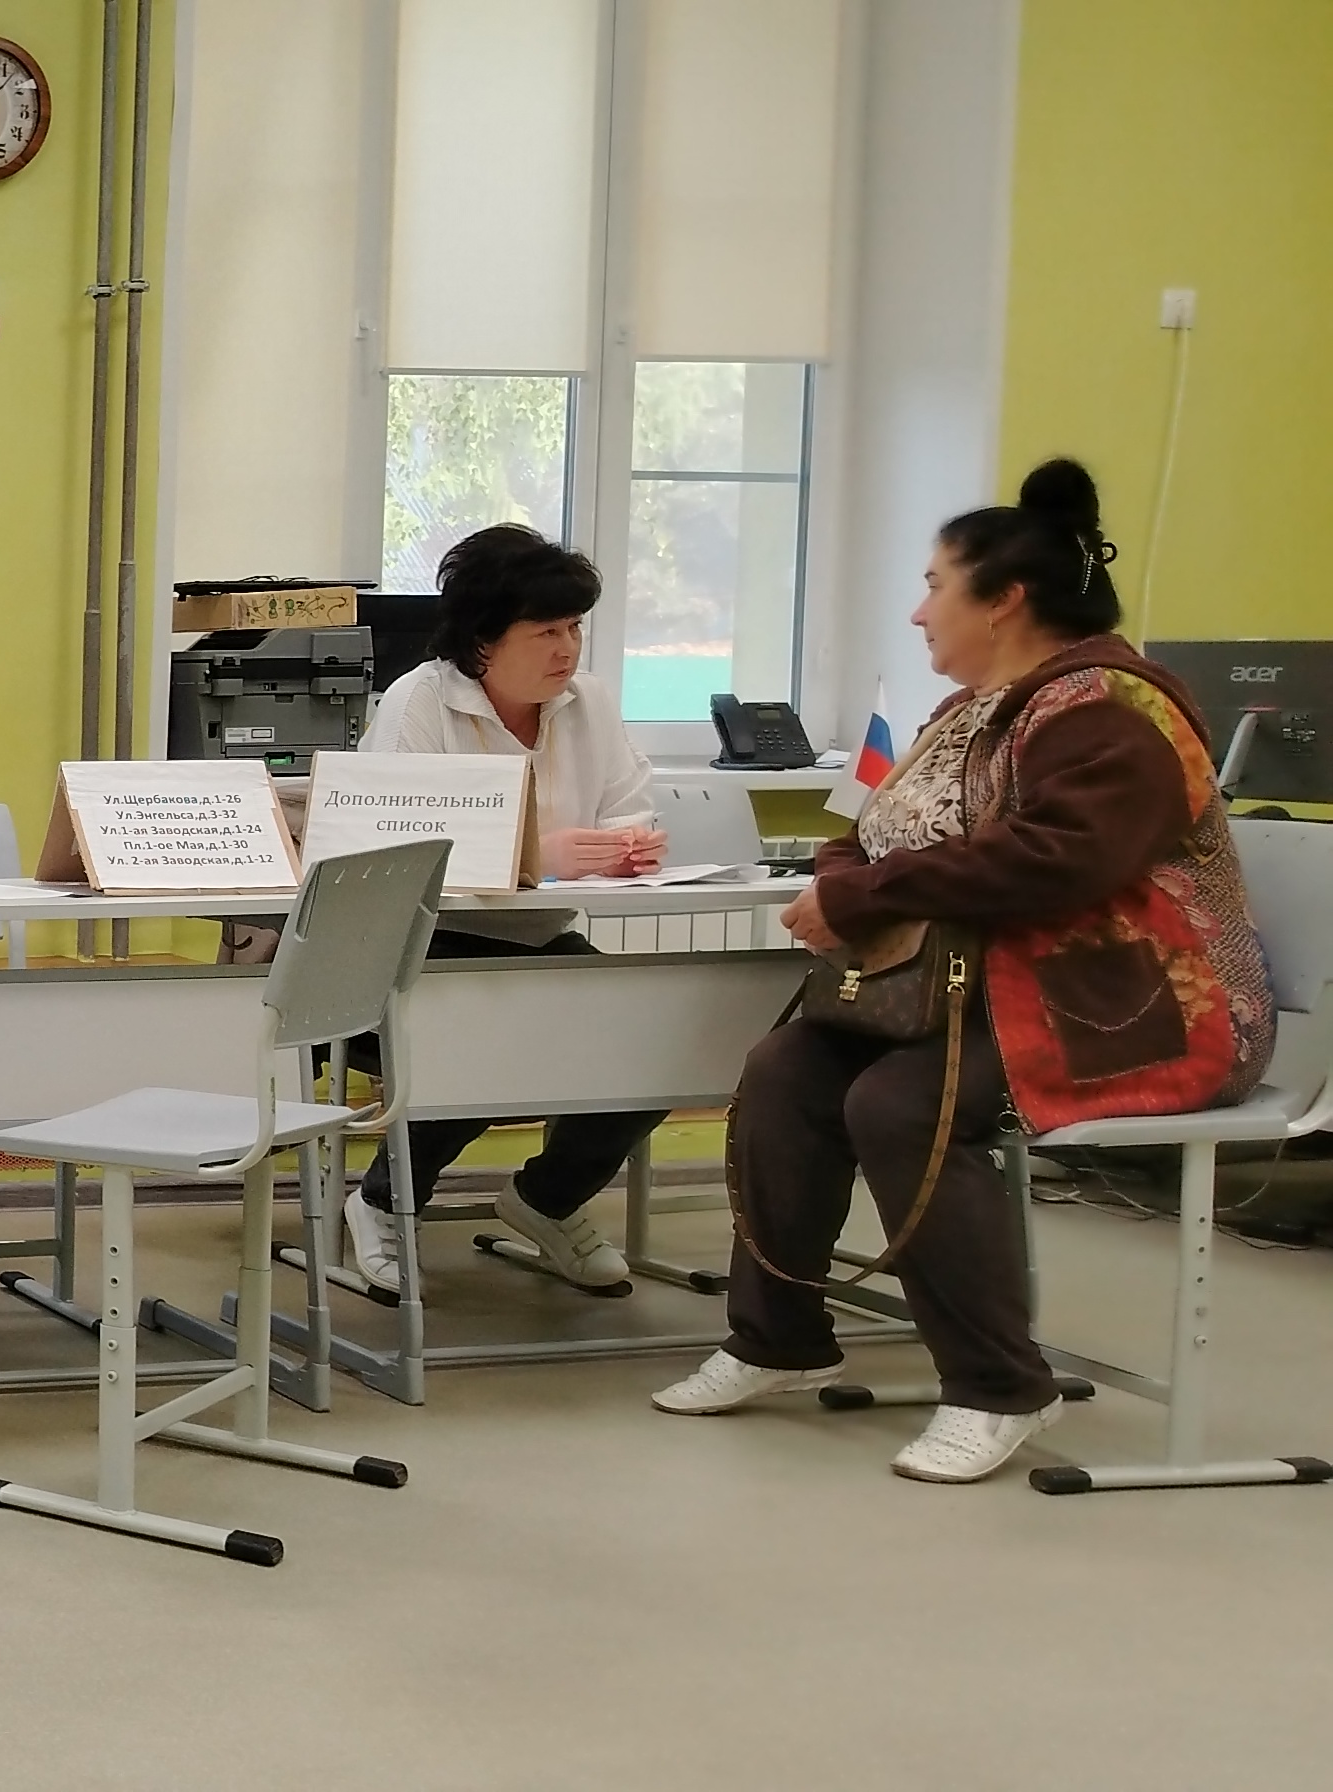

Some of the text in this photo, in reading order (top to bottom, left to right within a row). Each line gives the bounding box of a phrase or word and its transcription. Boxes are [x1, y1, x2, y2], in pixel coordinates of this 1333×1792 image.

[1229, 665, 1283, 683] acer
[103, 793, 242, 807] Ул.Щербакова,д.1-26
[324, 790, 505, 809] Дополнительный
[115, 809, 239, 823] Ул.Энгельса,д.3-32
[100, 824, 262, 837] Ул.1-ая Заводская,д.1-24
[376, 818, 447, 833] список
[123, 839, 249, 852] Пл.1-ое Мая,д.1-30
[106, 853, 275, 868] Ул. 2-ая Заводская,д.1-12
